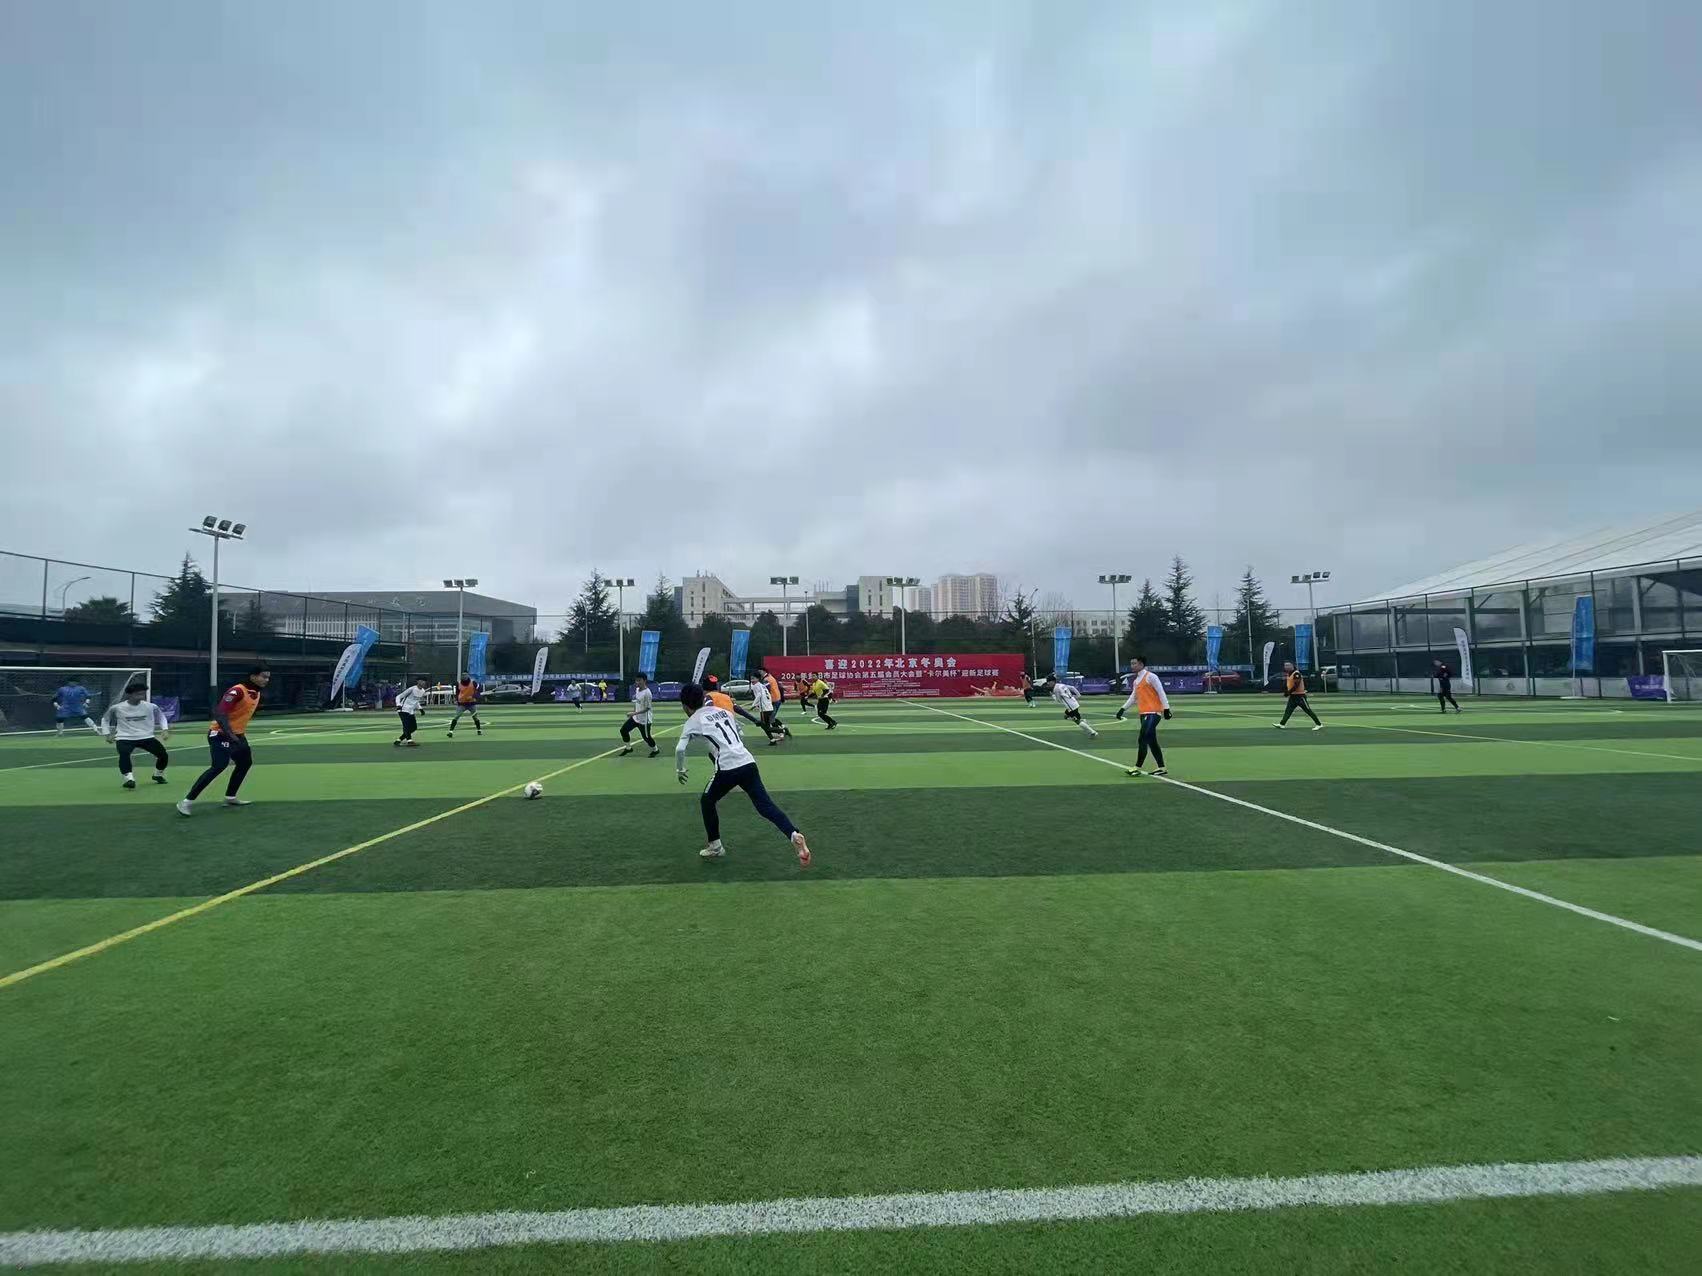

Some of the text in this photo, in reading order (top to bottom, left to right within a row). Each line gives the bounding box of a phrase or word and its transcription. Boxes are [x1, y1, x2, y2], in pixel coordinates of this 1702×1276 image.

[824, 656, 957, 670] 喜迎2022年北京冬奥会
[714, 719, 741, 745] 11
